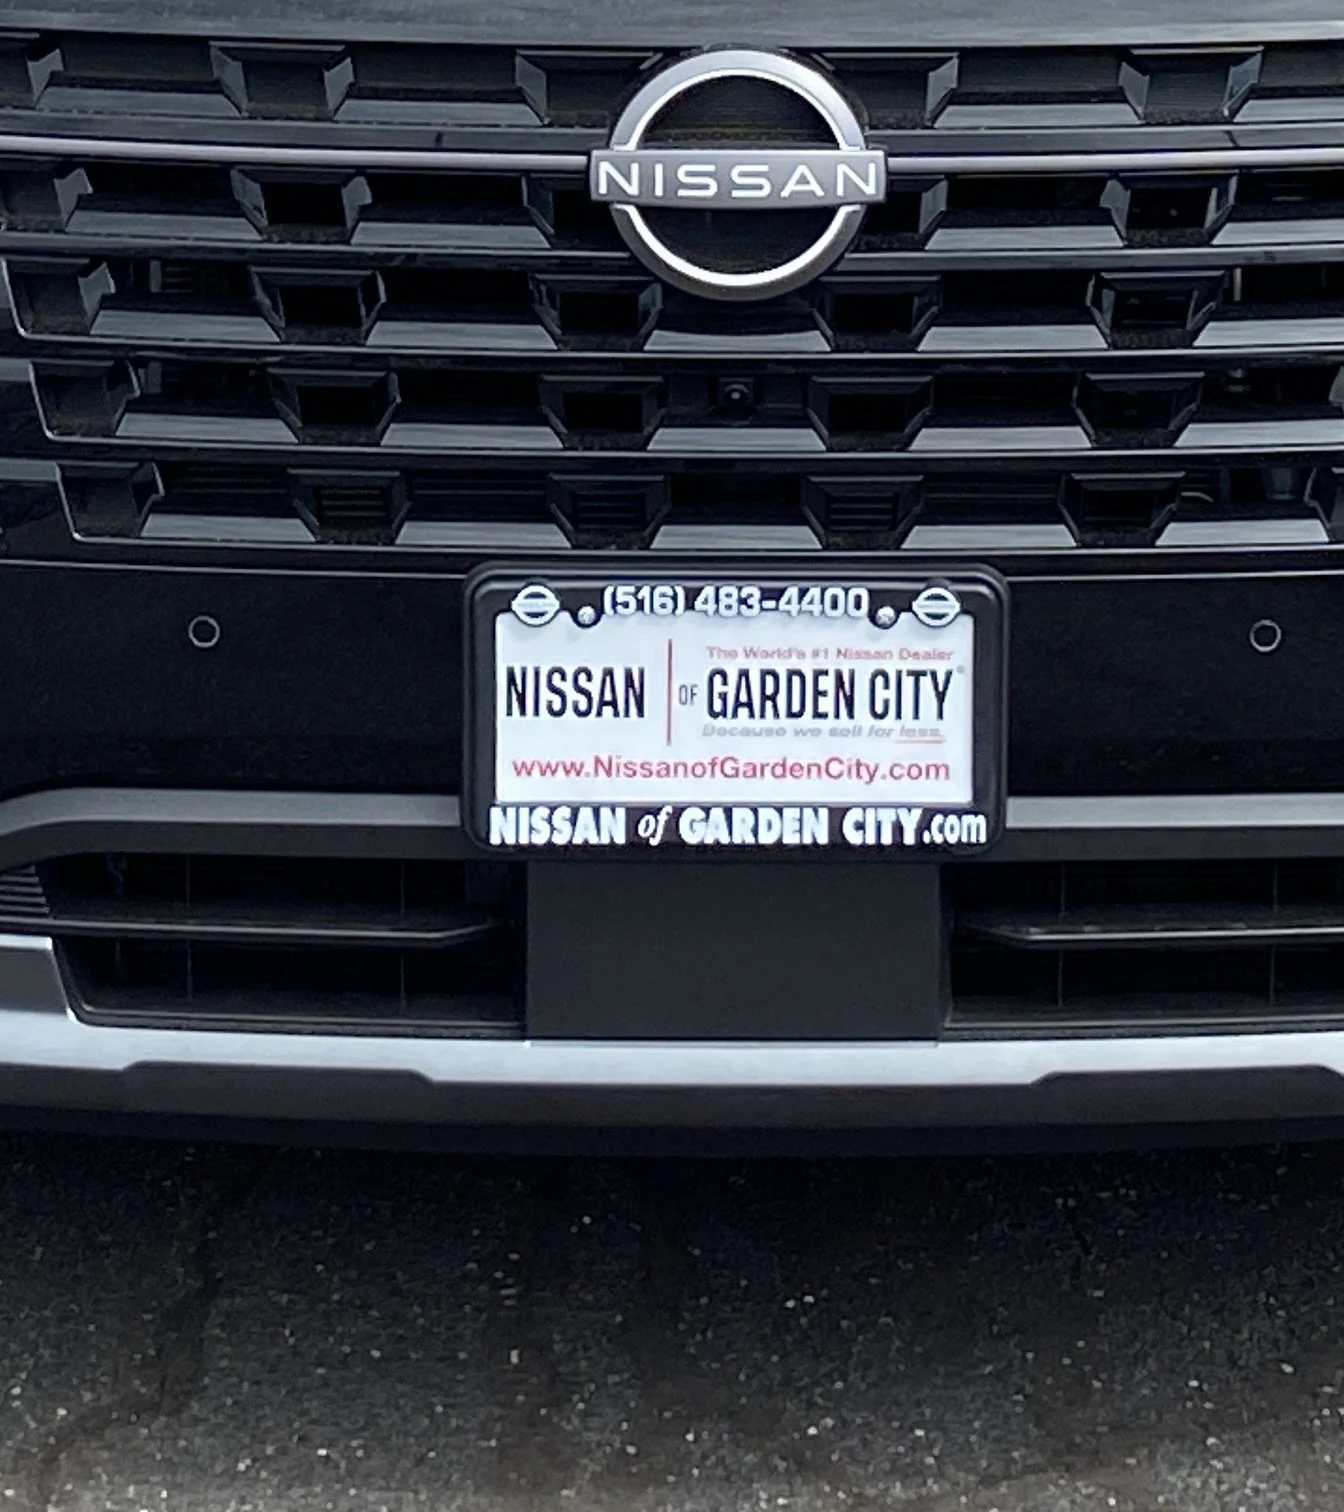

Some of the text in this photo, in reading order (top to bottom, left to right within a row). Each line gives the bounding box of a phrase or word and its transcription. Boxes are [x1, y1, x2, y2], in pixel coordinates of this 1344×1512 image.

[598, 160, 876, 198] NISSAN
[603, 585, 870, 617] (516) 483-4400
[706, 646, 738, 661] The
[836, 646, 892, 661] Nissan
[899, 646, 953, 662] Dealer
[505, 665, 953, 721] NISSAN OF GARDEN CITY
[702, 723, 787, 738] Because
[793, 726, 822, 738] we
[828, 723, 862, 738] sell
[867, 723, 894, 738] for
[512, 754, 950, 785] www.NissanofGardenCity.com
[489, 804, 987, 846] NISSAN of GARDEN CITY.com
